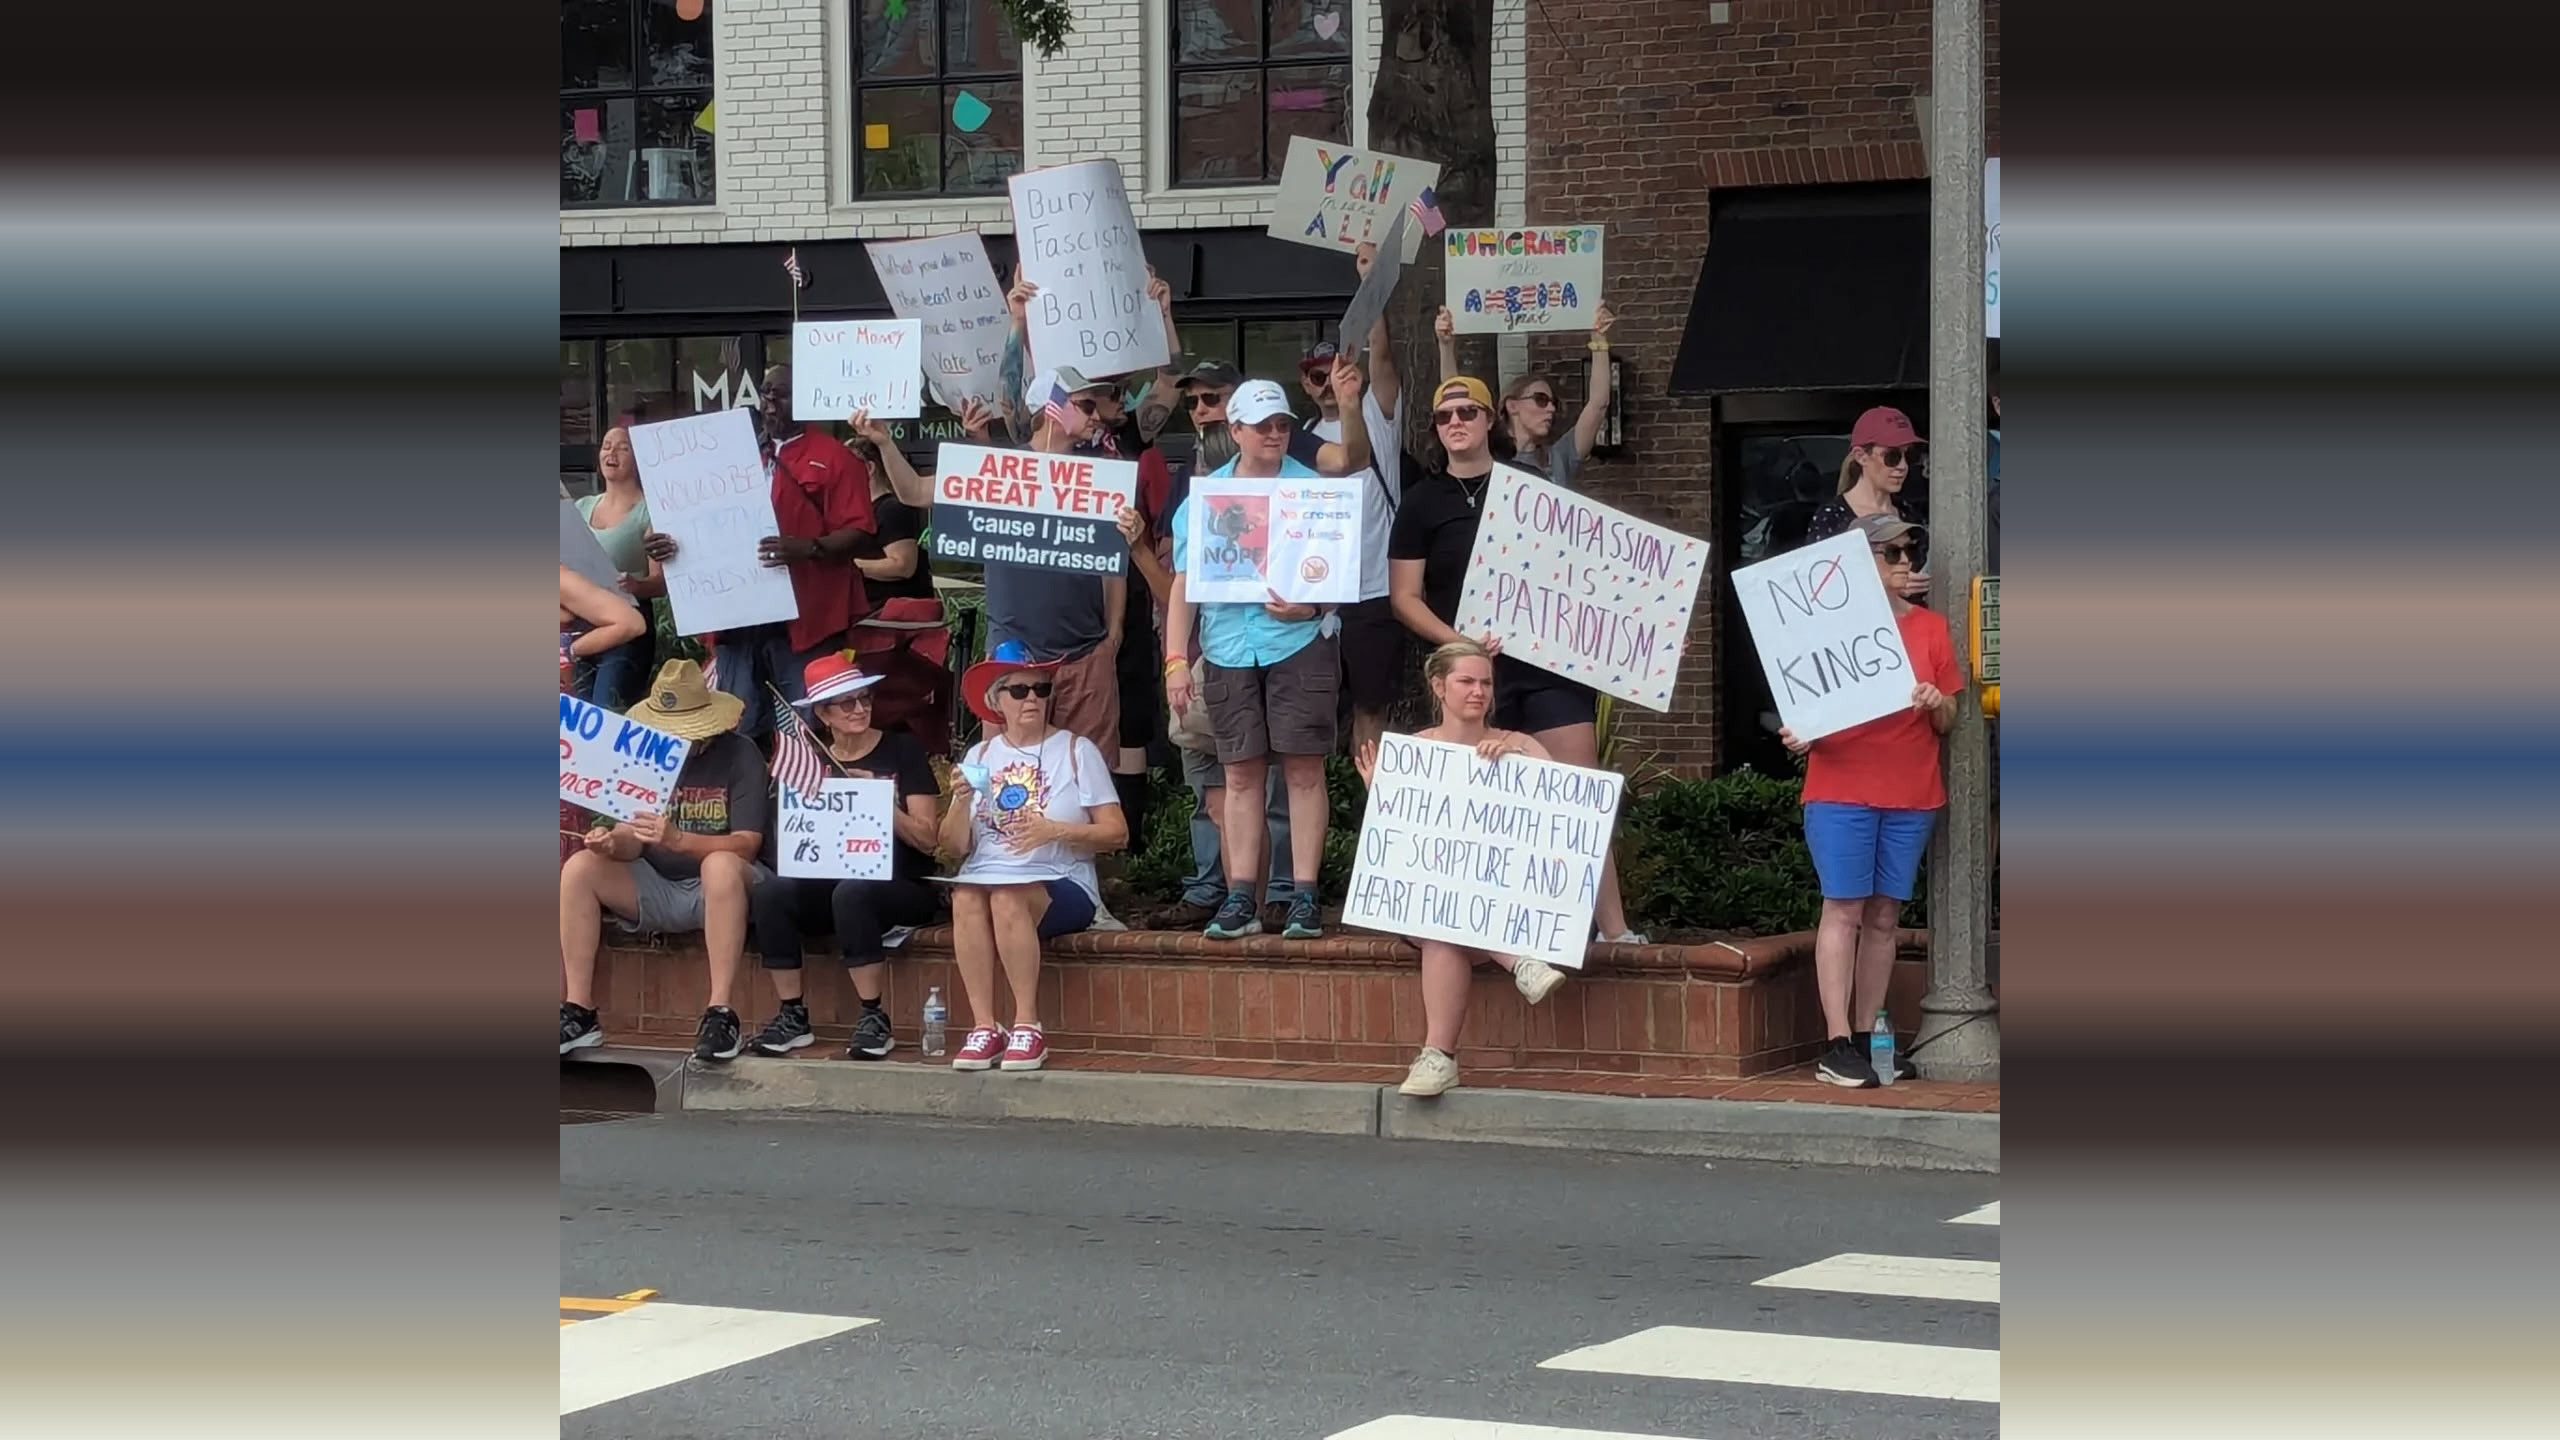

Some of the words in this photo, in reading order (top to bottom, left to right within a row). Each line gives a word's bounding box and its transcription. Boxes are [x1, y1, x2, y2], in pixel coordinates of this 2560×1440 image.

[1028, 189, 1094, 219] Bury
[959, 251, 974, 263] to
[1033, 224, 1129, 261] Fascists
[1448, 229, 1597, 256] IMMIGRANTS
[1064, 263, 1083, 278] at
[1103, 258, 1124, 273] the
[974, 286, 991, 299] us
[1043, 286, 1142, 326] Ballot
[1465, 281, 1578, 313] AMERICA
[809, 328, 845, 346] Our
[857, 328, 904, 349] Money
[924, 324, 940, 335] ou
[960, 318, 973, 330] to
[1080, 328, 1139, 358] BOX
[976, 347, 998, 366] for
[644, 420, 718, 467] JESUS
[920, 420, 966, 440] MAIN
[979, 454, 1039, 482] ARE
[1049, 460, 1093, 487] WE
[943, 476, 1042, 507] GREAT
[1052, 486, 1125, 516] YET?
[1280, 488, 1296, 499] No
[968, 510, 1035, 537] 'cause
[1042, 518, 1050, 539] I
[1053, 519, 1096, 545] just
[1280, 509, 1297, 519] No
[1514, 483, 1675, 581] COMPASSION
[937, 534, 976, 558] feel
[982, 542, 1121, 573] embarrassed
[1567, 563, 1596, 596] IS
[1768, 555, 1850, 625] NO
[1496, 572, 1656, 680] PATRIOTISM
[1777, 627, 1902, 705] KINGS
[560, 695, 604, 741] NO
[613, 720, 682, 772] KING
[617, 779, 657, 804] 1776
[1467, 752, 1529, 798] WALK
[1533, 766, 1615, 814] AROUND
[784, 813, 815, 833] like
[1376, 783, 1432, 827] WITH
[1435, 795, 1451, 829] A
[1462, 799, 1541, 847] MOUTH
[1550, 814, 1600, 858] FULL
[845, 839, 882, 853] 1776
[1366, 828, 1403, 867] OF
[1406, 834, 1515, 889] SCRIPTURE
[1523, 854, 1568, 898] AND
[1578, 862, 1596, 909] A
[1351, 873, 1416, 923] HEART
[1421, 884, 1462, 930] FULL
[1470, 894, 1496, 936] OF
[1503, 903, 1572, 952] HATE
